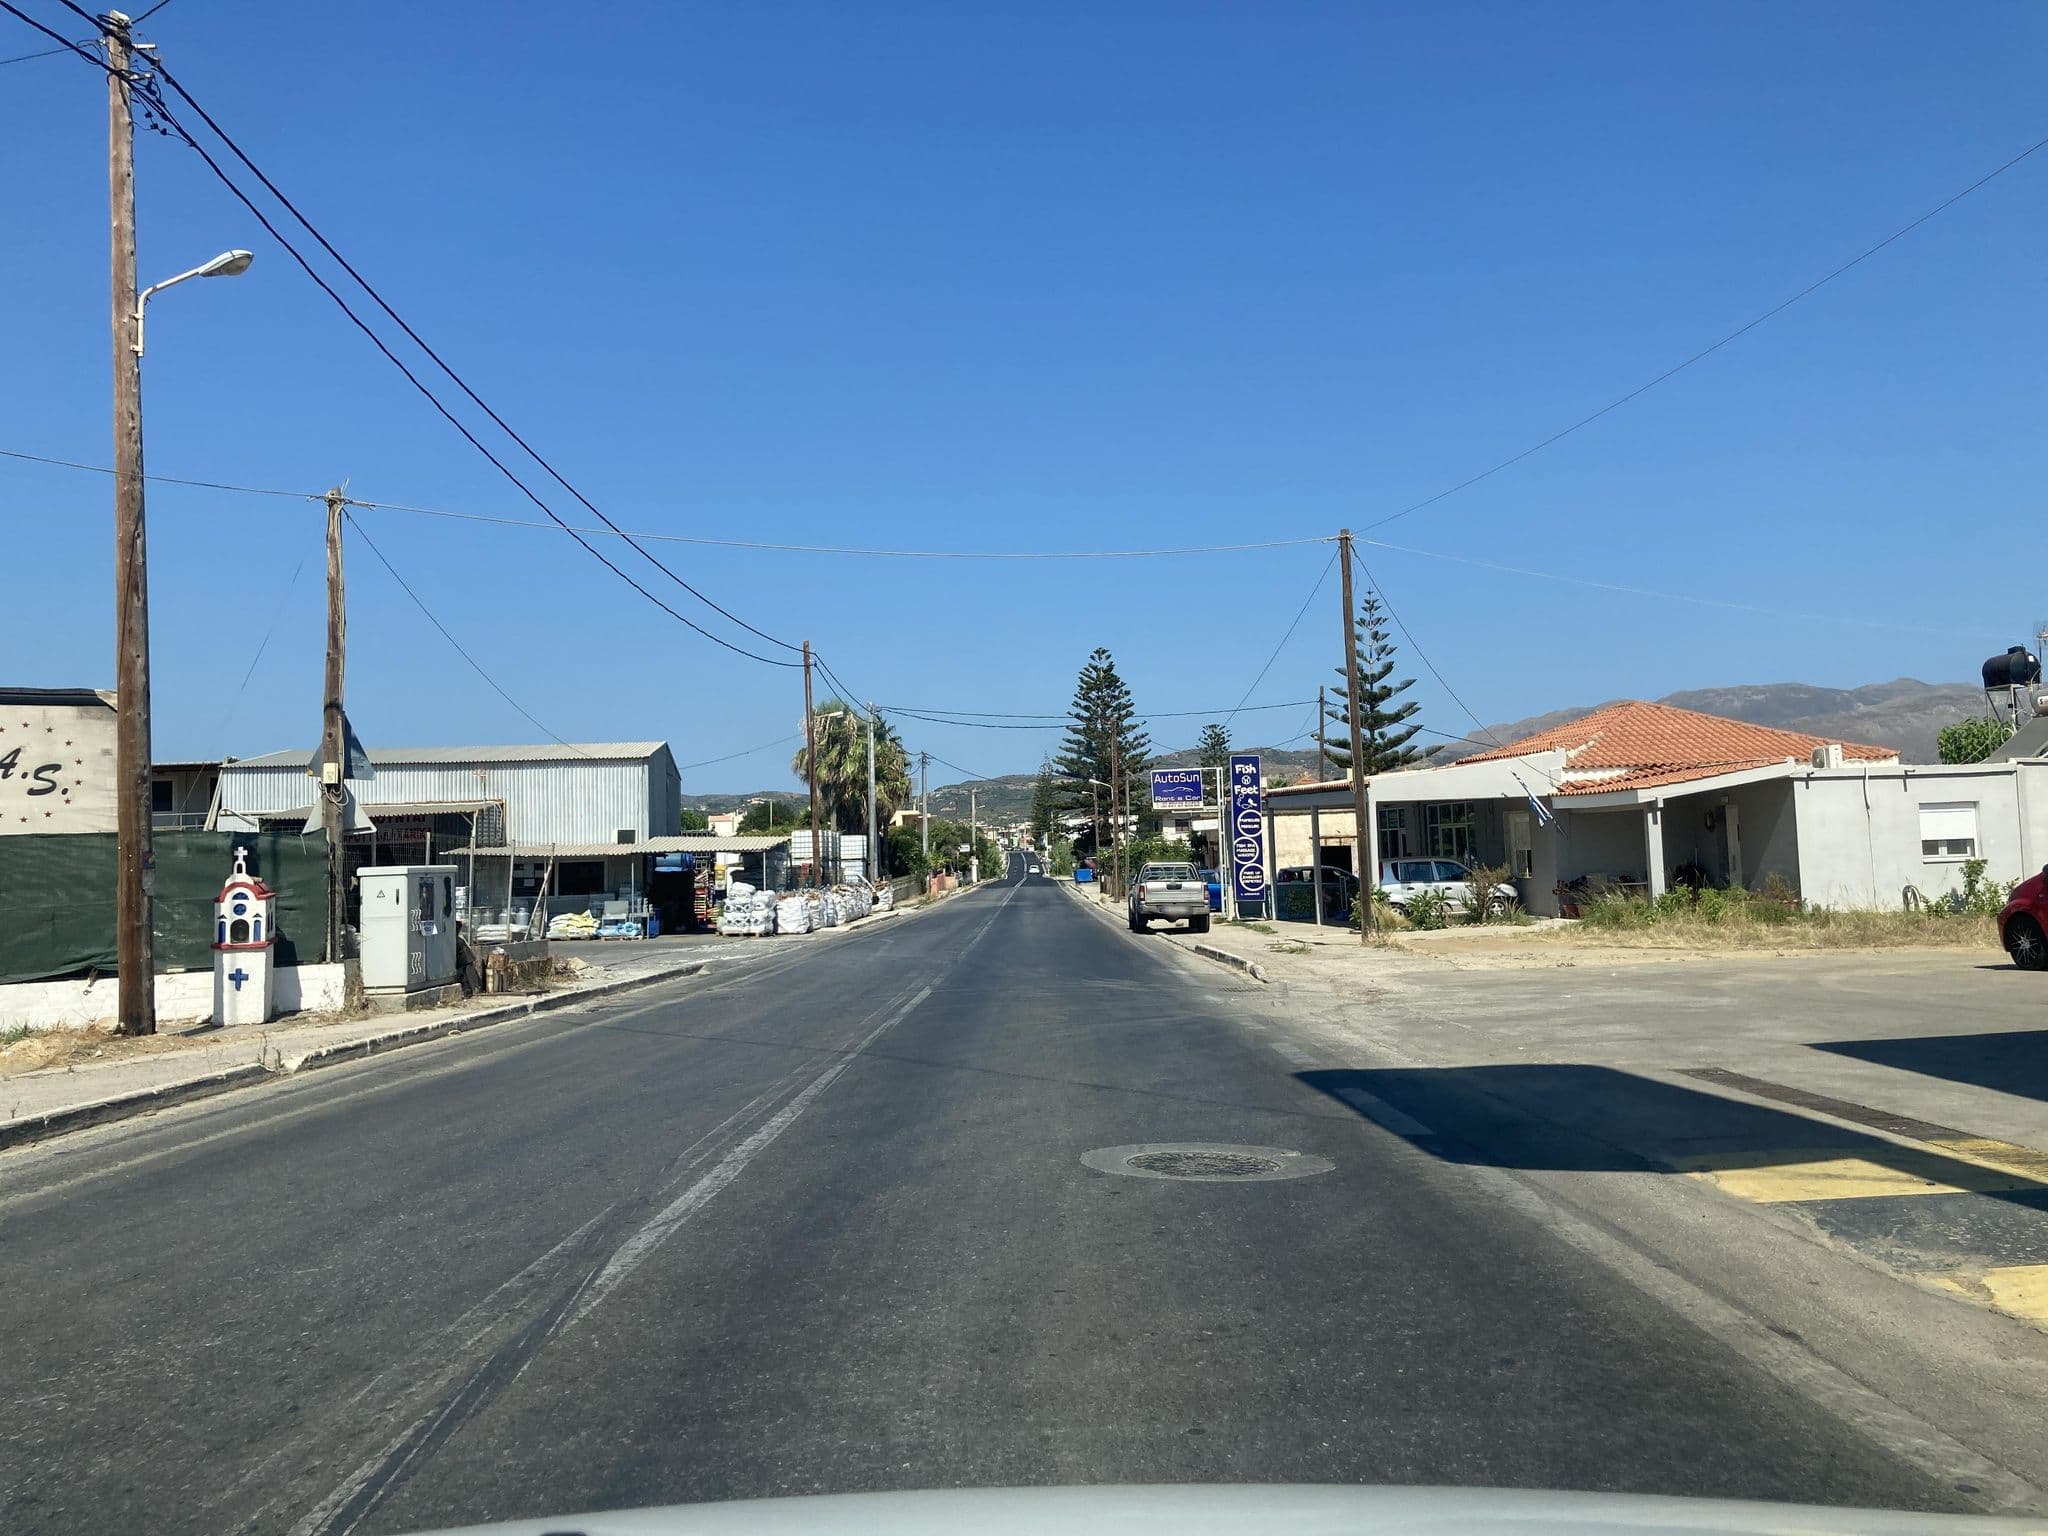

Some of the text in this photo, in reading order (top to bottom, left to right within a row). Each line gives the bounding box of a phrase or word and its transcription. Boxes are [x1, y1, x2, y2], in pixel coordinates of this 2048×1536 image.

[1235, 763, 1257, 774] Fish
[1154, 773, 1199, 784] AutoSun
[1234, 784, 1259, 795] Feet
